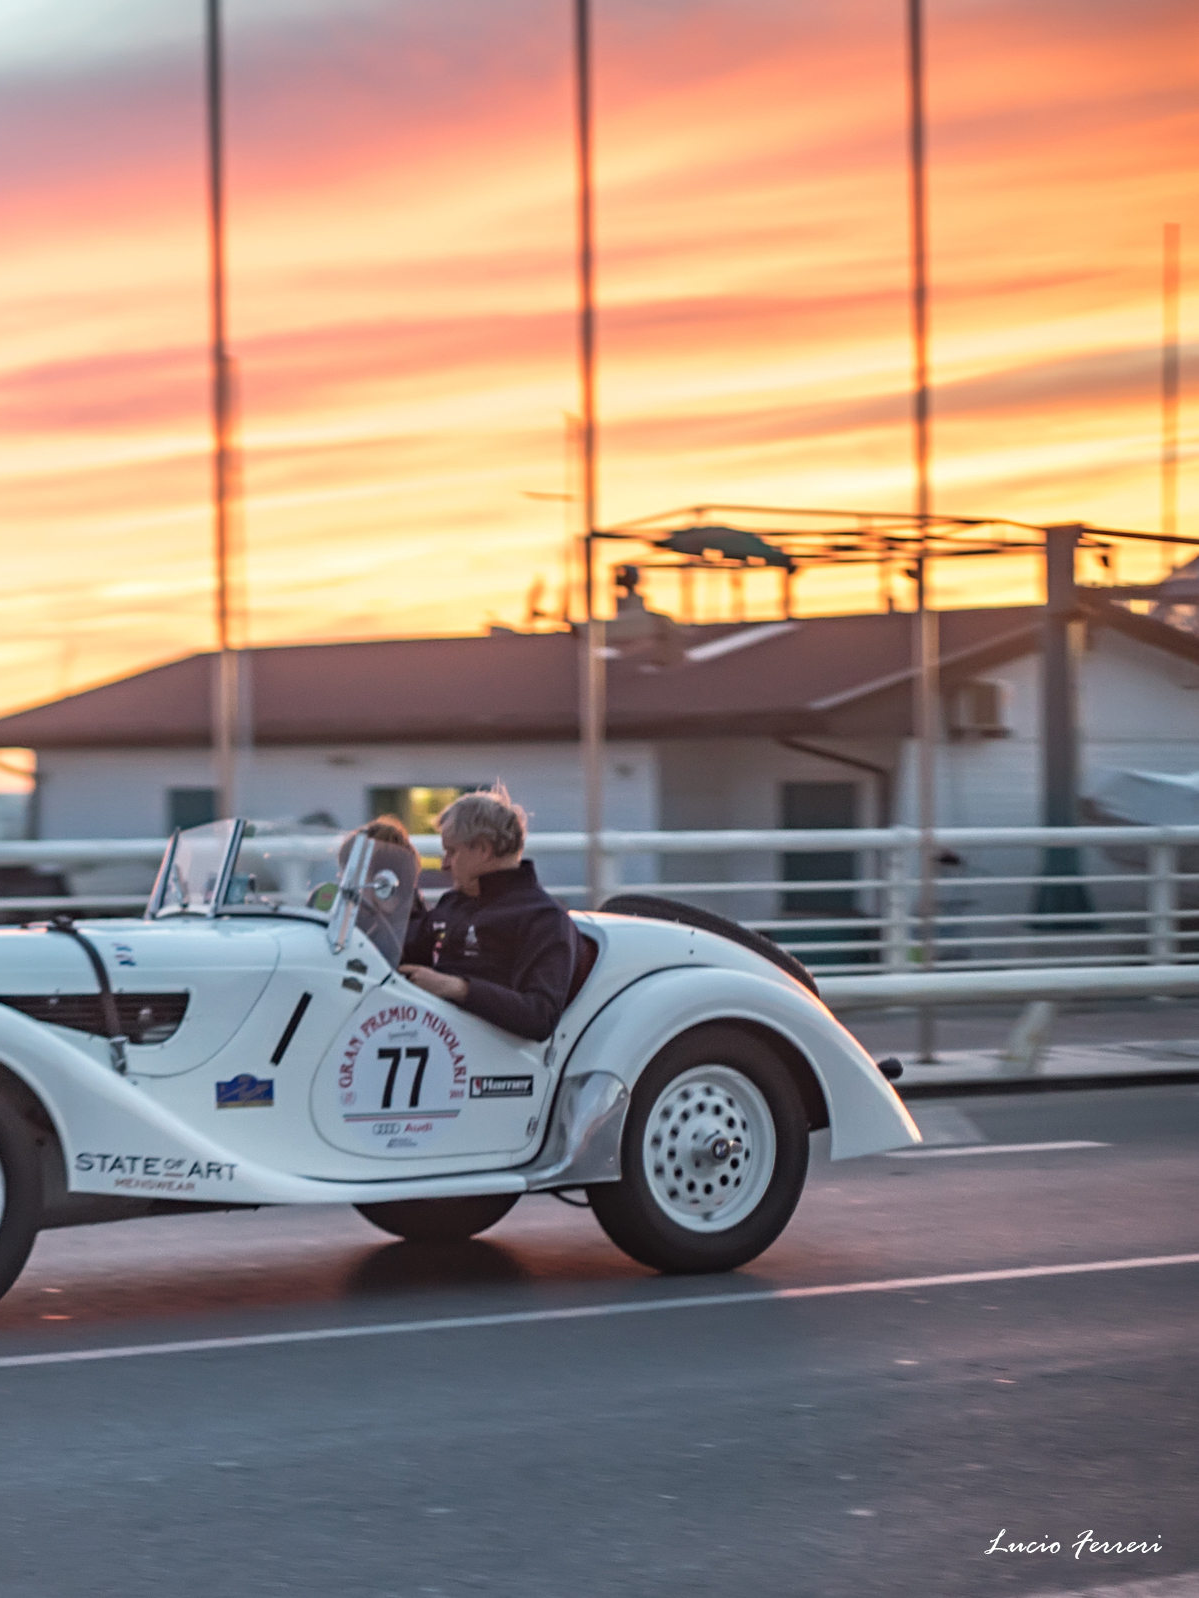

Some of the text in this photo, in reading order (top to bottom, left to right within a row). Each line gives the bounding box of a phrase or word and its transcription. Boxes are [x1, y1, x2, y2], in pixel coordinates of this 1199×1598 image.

[338, 1005, 467, 1089] GRAN PREMIO NUVOLARI
[377, 1046, 430, 1110] 77
[404, 1122, 434, 1134] Audi
[75, 1152, 239, 1182] STATE OF ART
[114, 1178, 196, 1192] MENSWEAR
